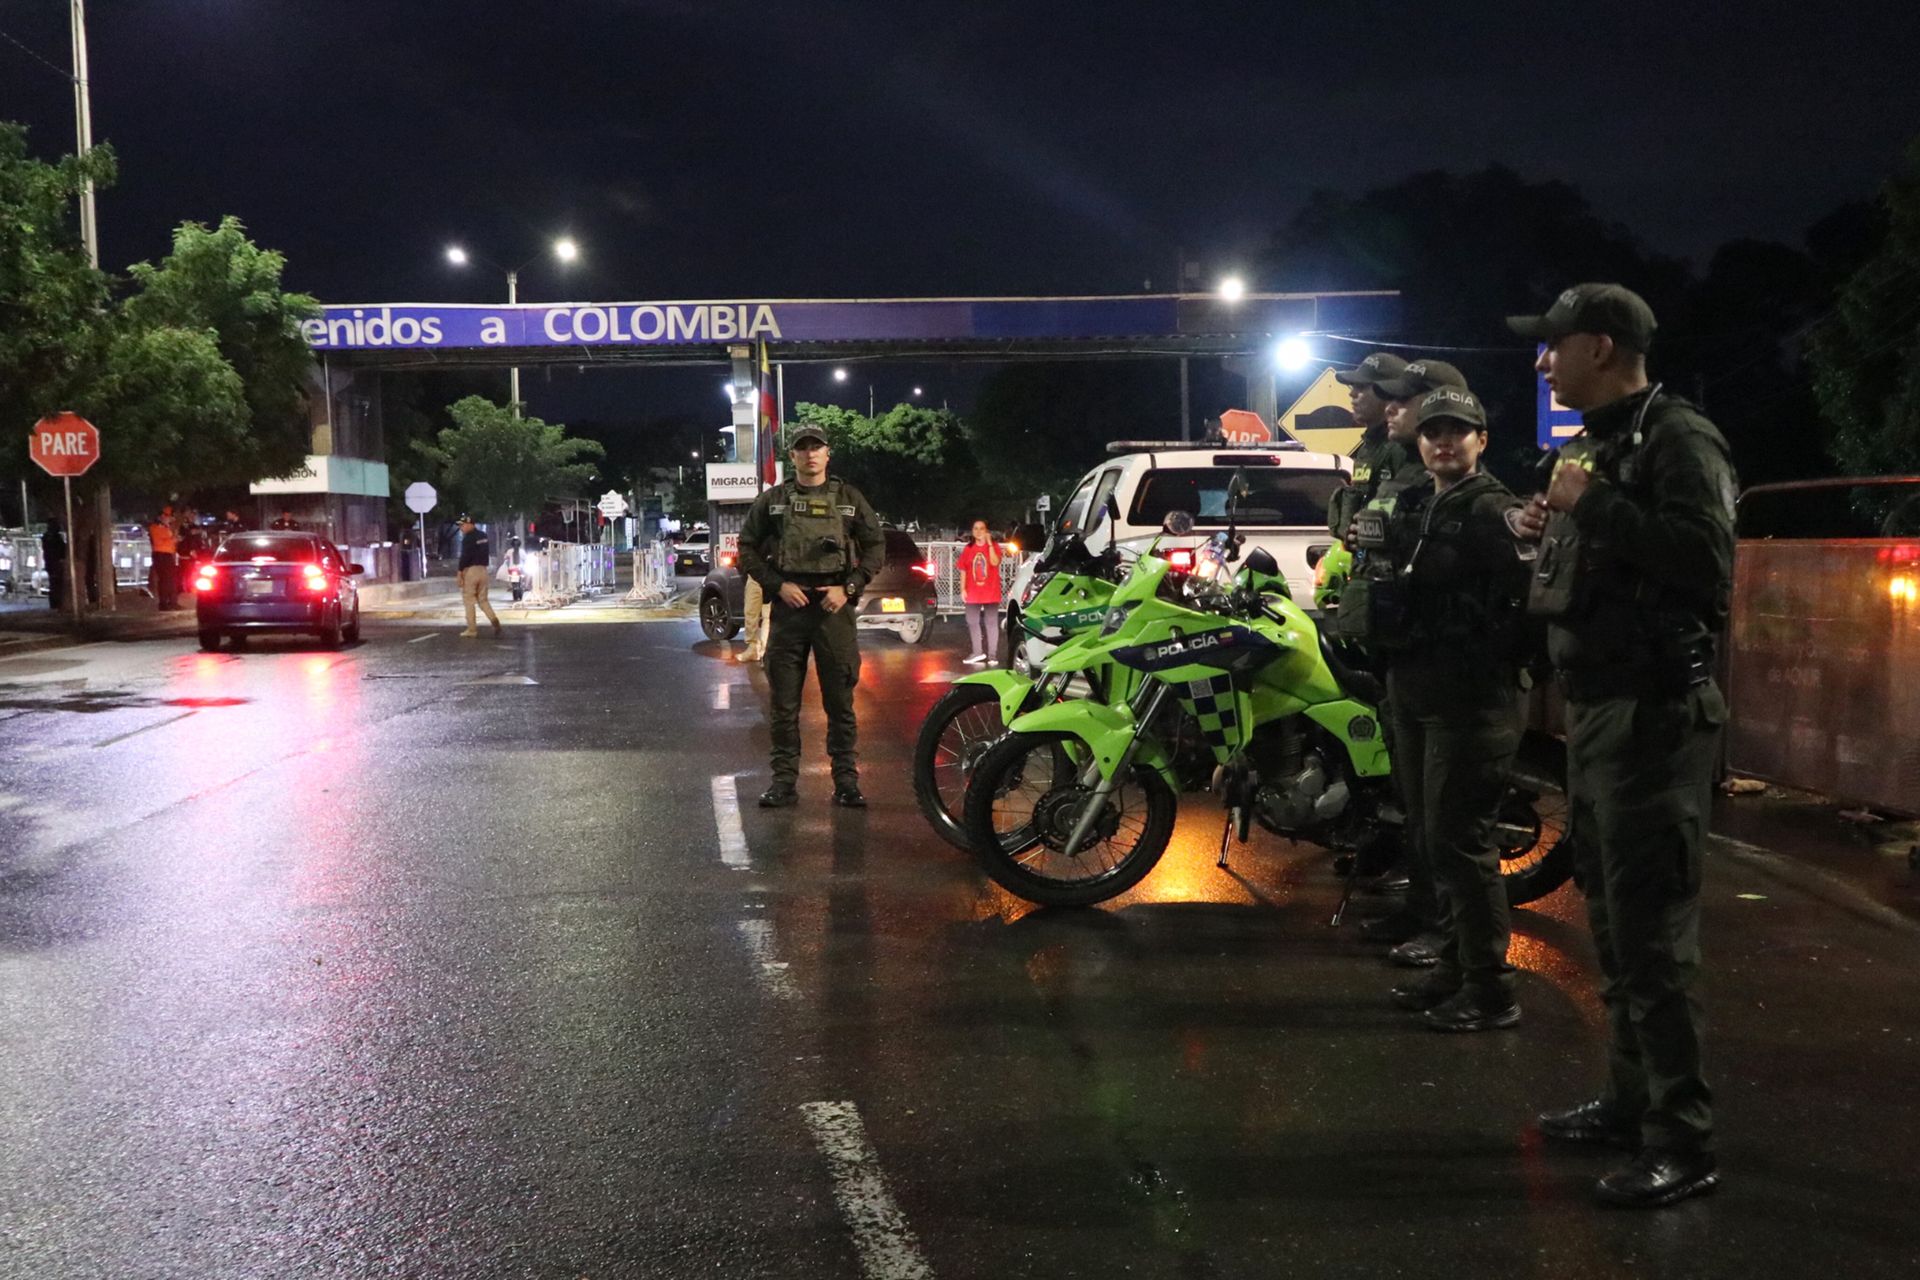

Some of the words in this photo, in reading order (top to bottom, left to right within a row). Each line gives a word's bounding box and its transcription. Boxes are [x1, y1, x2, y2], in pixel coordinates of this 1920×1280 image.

[300, 308, 443, 346] enidos
[480, 316, 506, 344] a
[544, 304, 782, 342] COLOMBIA
[40, 431, 89, 456] PARE
[711, 477, 760, 486] MIGRACI
[1158, 633, 1218, 658] POLICÍA
